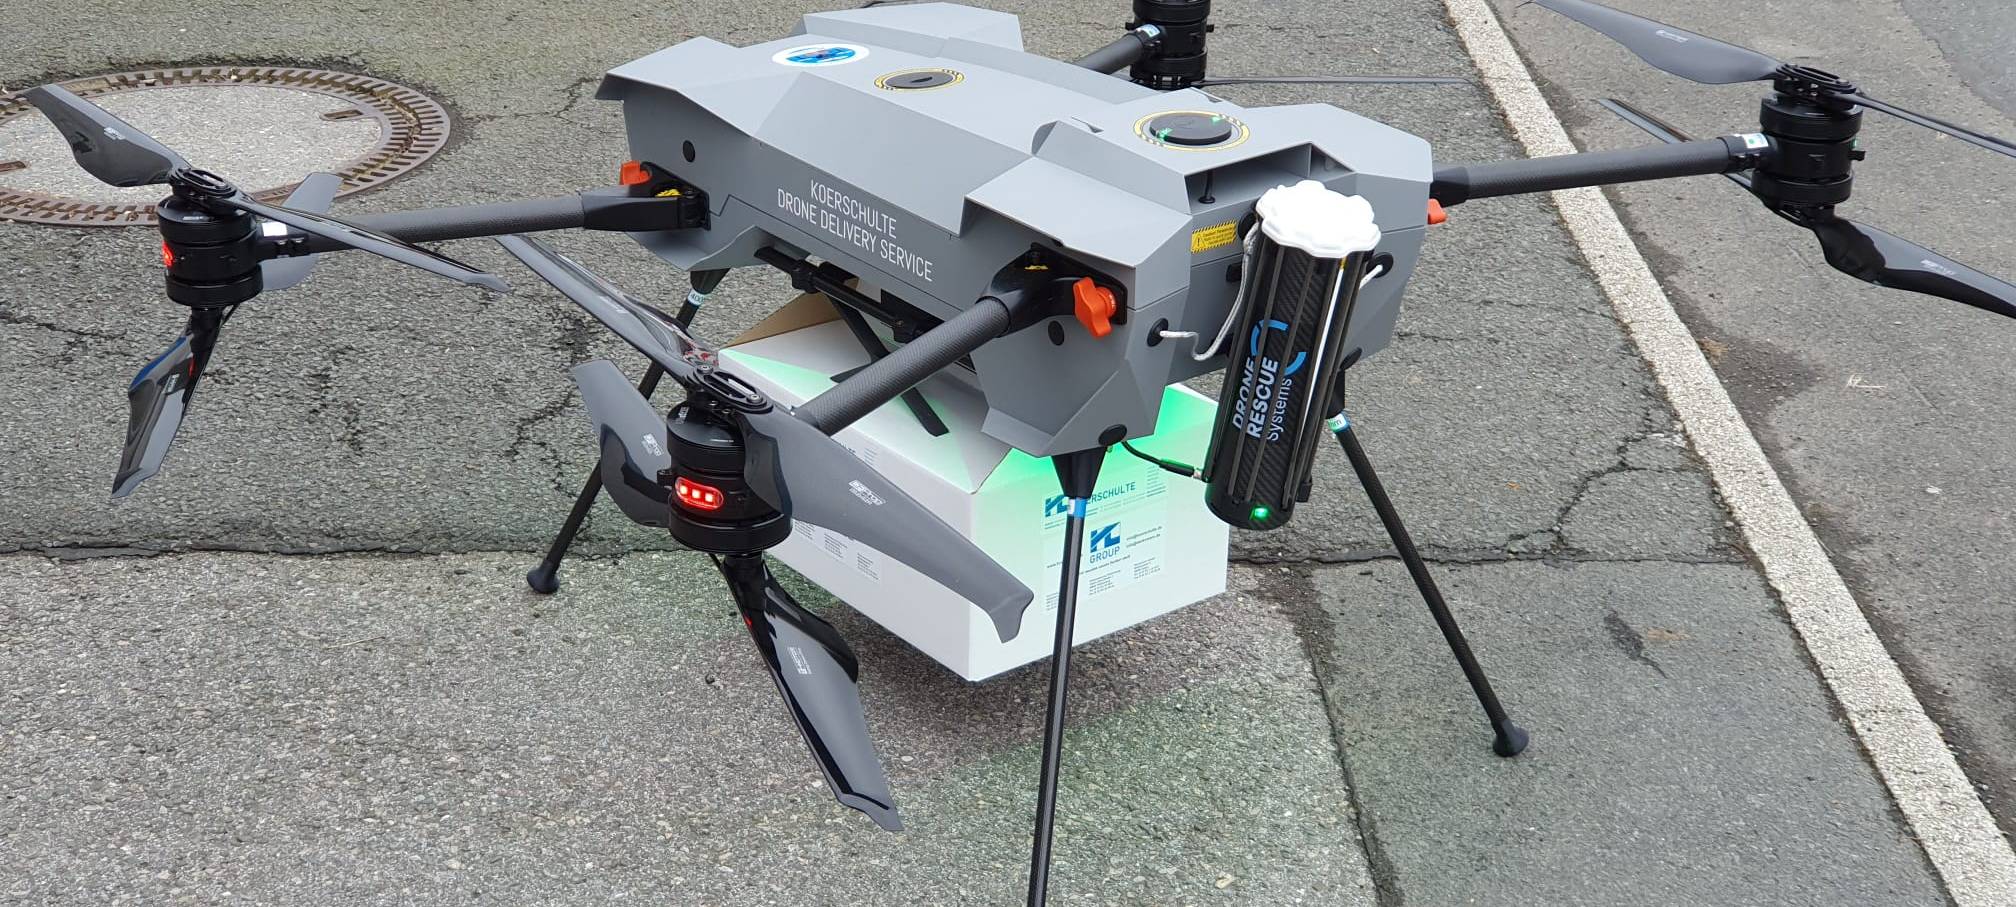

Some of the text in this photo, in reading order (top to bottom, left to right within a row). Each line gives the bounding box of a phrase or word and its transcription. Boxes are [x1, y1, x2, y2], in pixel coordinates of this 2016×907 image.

[777, 188, 933, 282] DRONE DELIVERY SERVICE
[811, 179, 897, 239] KOERSCHULTE
[1232, 356, 1255, 430] DRONE
[1246, 356, 1279, 438] RESCUE
[1087, 481, 1136, 505] RSCHULTE
[1089, 545, 1121, 564] GROUP
